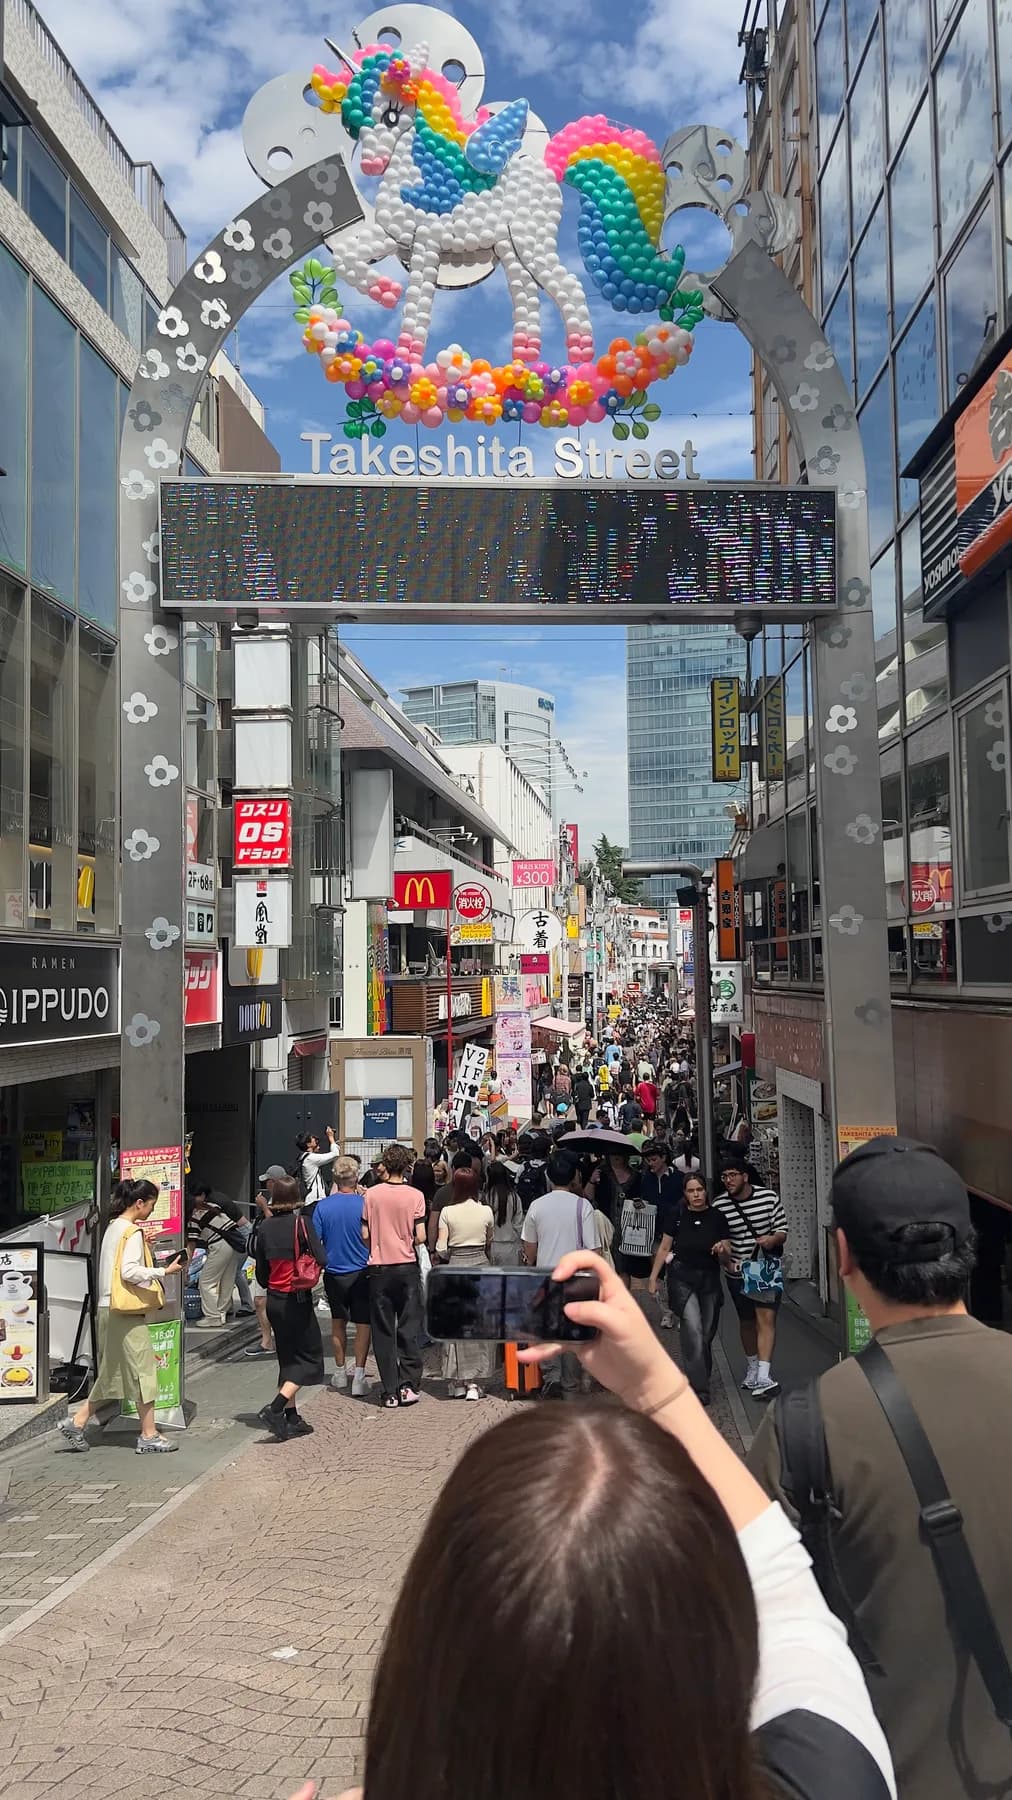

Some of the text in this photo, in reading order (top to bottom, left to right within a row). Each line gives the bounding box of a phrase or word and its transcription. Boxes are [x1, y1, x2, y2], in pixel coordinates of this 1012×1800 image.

[300, 432, 701, 480] Takeshita Street
[718, 680, 737, 768] コインロッカー
[240, 803, 284, 817] クスリ
[238, 821, 285, 843] OS
[238, 847, 286, 860] ドラッグ
[516, 871, 550, 884] ¥300
[458, 896, 483, 909] 消火栓
[532, 911, 549, 949] 古着
[31, 957, 75, 969] RAMEN
[11, 986, 109, 1024] IPPUDO
[239, 1000, 271, 1032] DOUTOR
